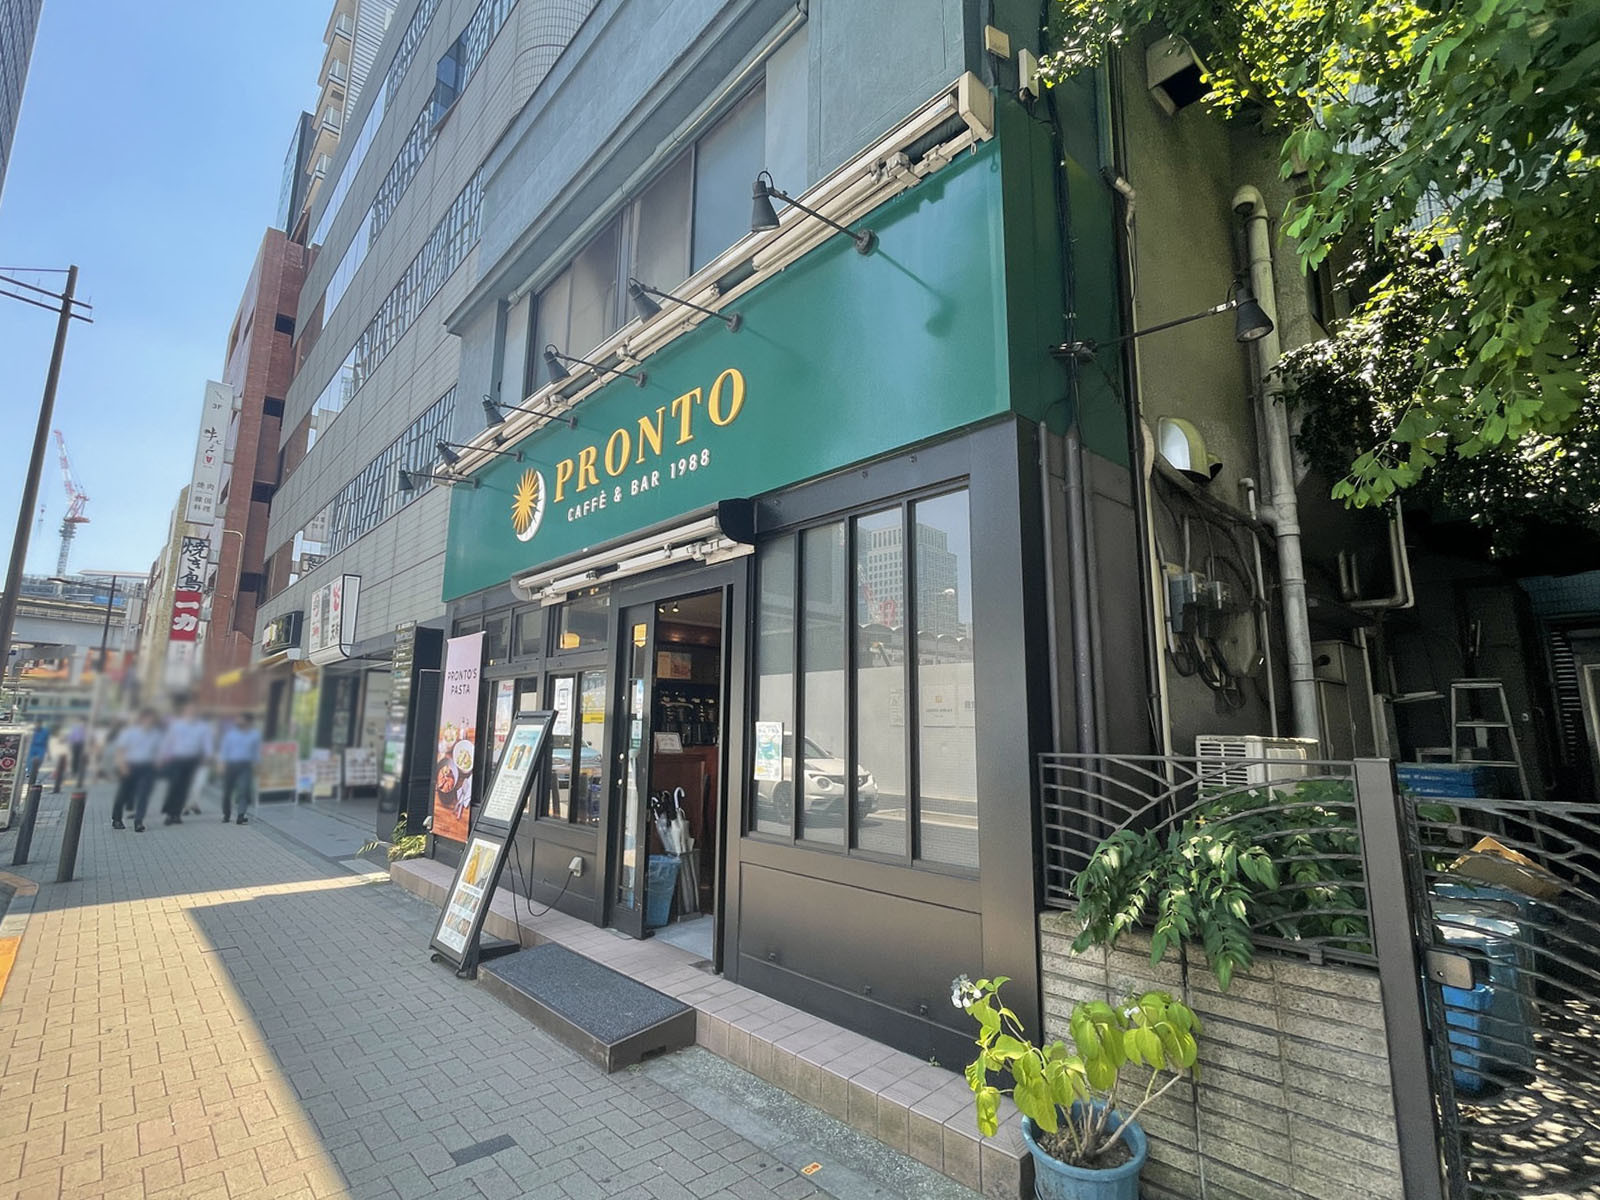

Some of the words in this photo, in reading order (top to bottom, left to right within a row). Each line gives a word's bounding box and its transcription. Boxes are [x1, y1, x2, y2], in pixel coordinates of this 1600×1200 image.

[553, 367, 746, 503] PRONTO
[567, 489, 607, 522] CAFFÈ
[613, 485, 622, 503] &
[630, 470, 660, 496] BAR
[669, 448, 711, 479] 1988
[178, 538, 209, 593] 焼き鳥
[172, 601, 200, 631] 一力
[451, 684, 470, 695] PASTA
